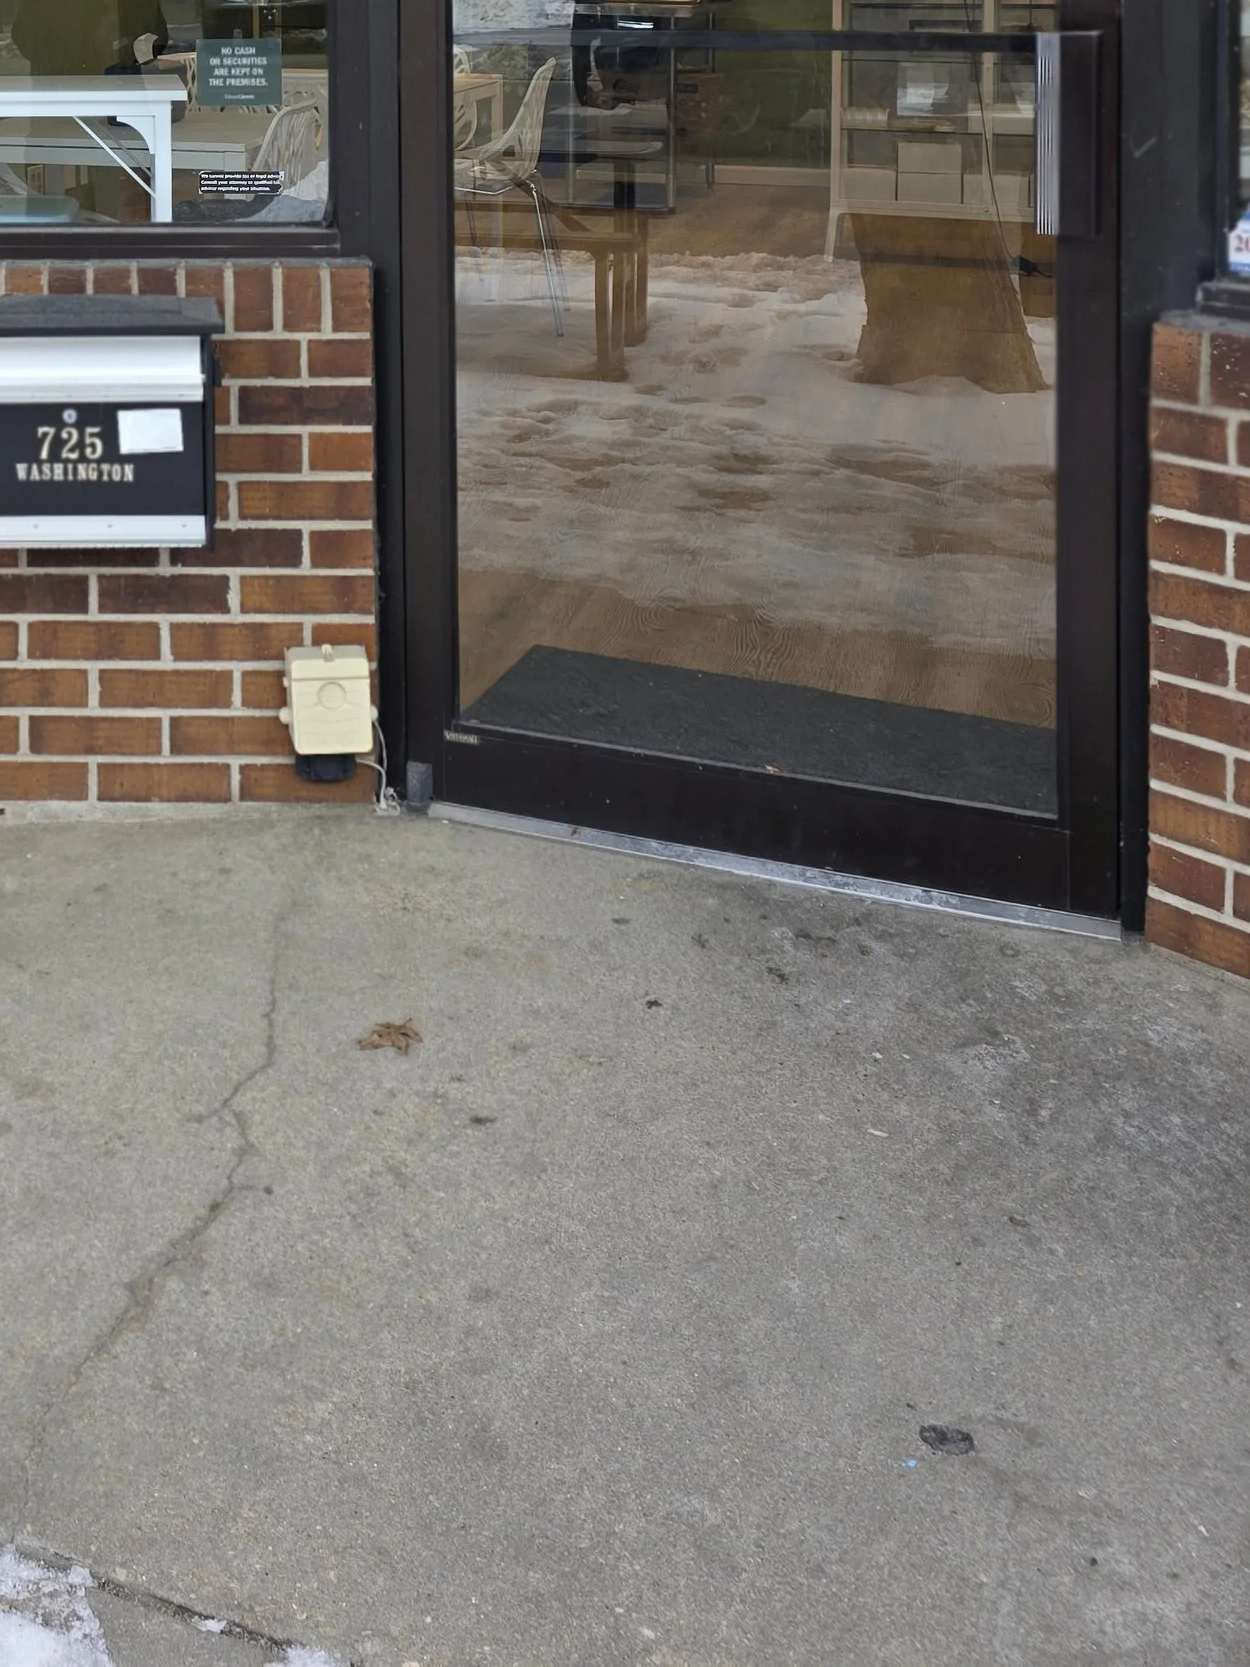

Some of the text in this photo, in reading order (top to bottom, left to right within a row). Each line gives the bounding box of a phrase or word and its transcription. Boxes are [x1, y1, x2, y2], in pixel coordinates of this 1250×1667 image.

[221, 46, 256, 55] NO CASH
[210, 56, 268, 66] OR SECURITIES
[213, 68, 264, 76] ARE KEPT ON
[208, 78, 268, 86] THE PREMISES.
[37, 426, 104, 460] 725
[16, 463, 135, 483] WASHINGTON
